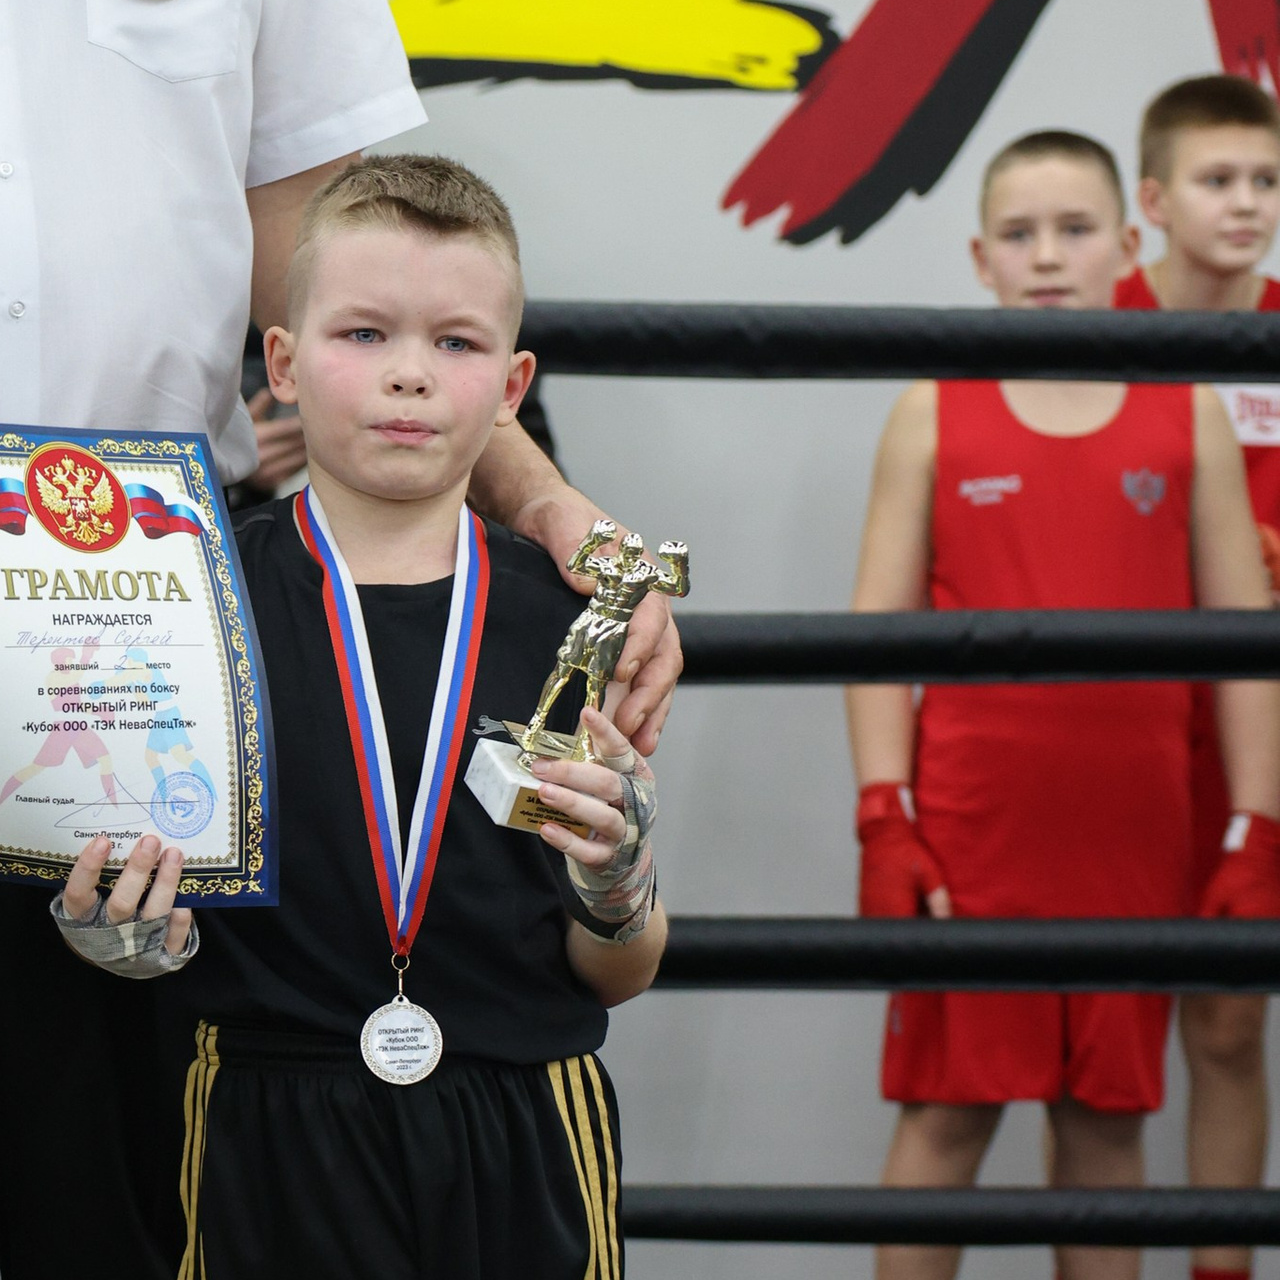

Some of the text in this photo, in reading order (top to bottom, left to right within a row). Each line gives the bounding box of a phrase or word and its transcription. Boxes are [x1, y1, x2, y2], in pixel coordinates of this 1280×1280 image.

[1, 568, 192, 602] ГРАМОТА
[52, 614, 153, 628] НАГРАЖДАЕТСЯ
[54, 661, 100, 671] занявший
[145, 662, 171, 670] место
[47, 684, 132, 697] соревнованиях
[134, 685, 148, 694] по
[150, 682, 180, 695] боксу
[62, 699, 159, 713] ОТКРЫТЫЙ РИНГ
[63, 721, 88, 731] ООО
[15, 795, 75, 806] Главный судья
